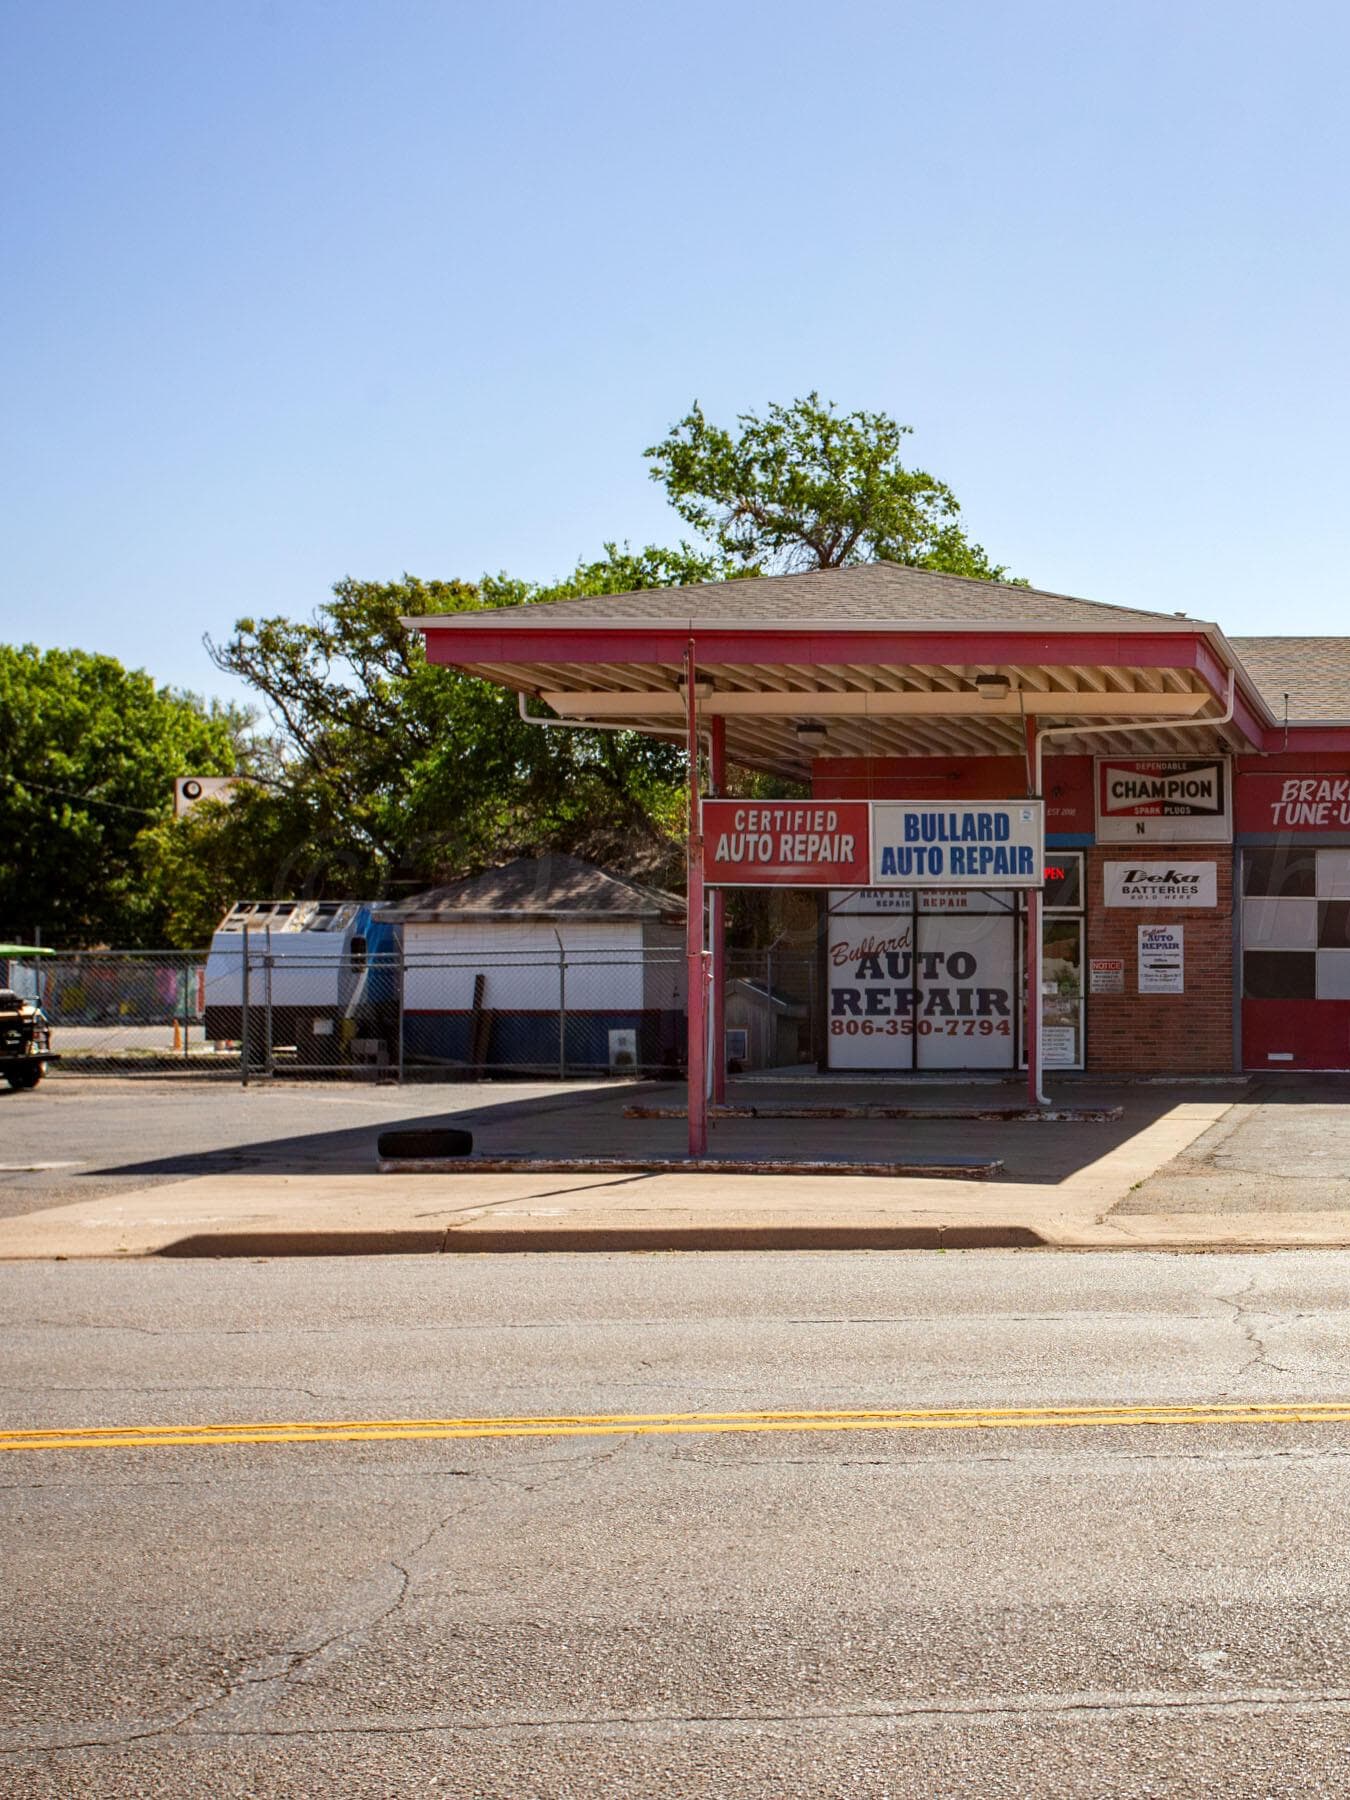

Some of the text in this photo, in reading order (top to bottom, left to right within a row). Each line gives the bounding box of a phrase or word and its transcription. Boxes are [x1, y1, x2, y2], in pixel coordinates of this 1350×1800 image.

[1136, 762, 1187, 771] DEPENDABLE
[1111, 780, 1212, 799] CHAMPION
[1134, 806, 1191, 815] SPARK PLUGS
[734, 809, 838, 831] CERTIFIED
[904, 813, 1010, 842] BULLARD
[1137, 823, 1145, 834] N
[715, 833, 856, 864] AUTO REPAIR
[881, 846, 1034, 876] AUTO REPAIR
[1044, 867, 1065, 880] PEN
[1123, 870, 1200, 884] Deka
[1122, 886, 1199, 894] BATTERIES
[923, 899, 968, 907] REPAIR
[830, 926, 912, 966] Bullard
[855, 951, 977, 980] AUTO
[1093, 962, 1120, 970] NOTICE
[831, 988, 1011, 1016] REPAIR
[830, 1020, 1011, 1036] 806-350-7794
